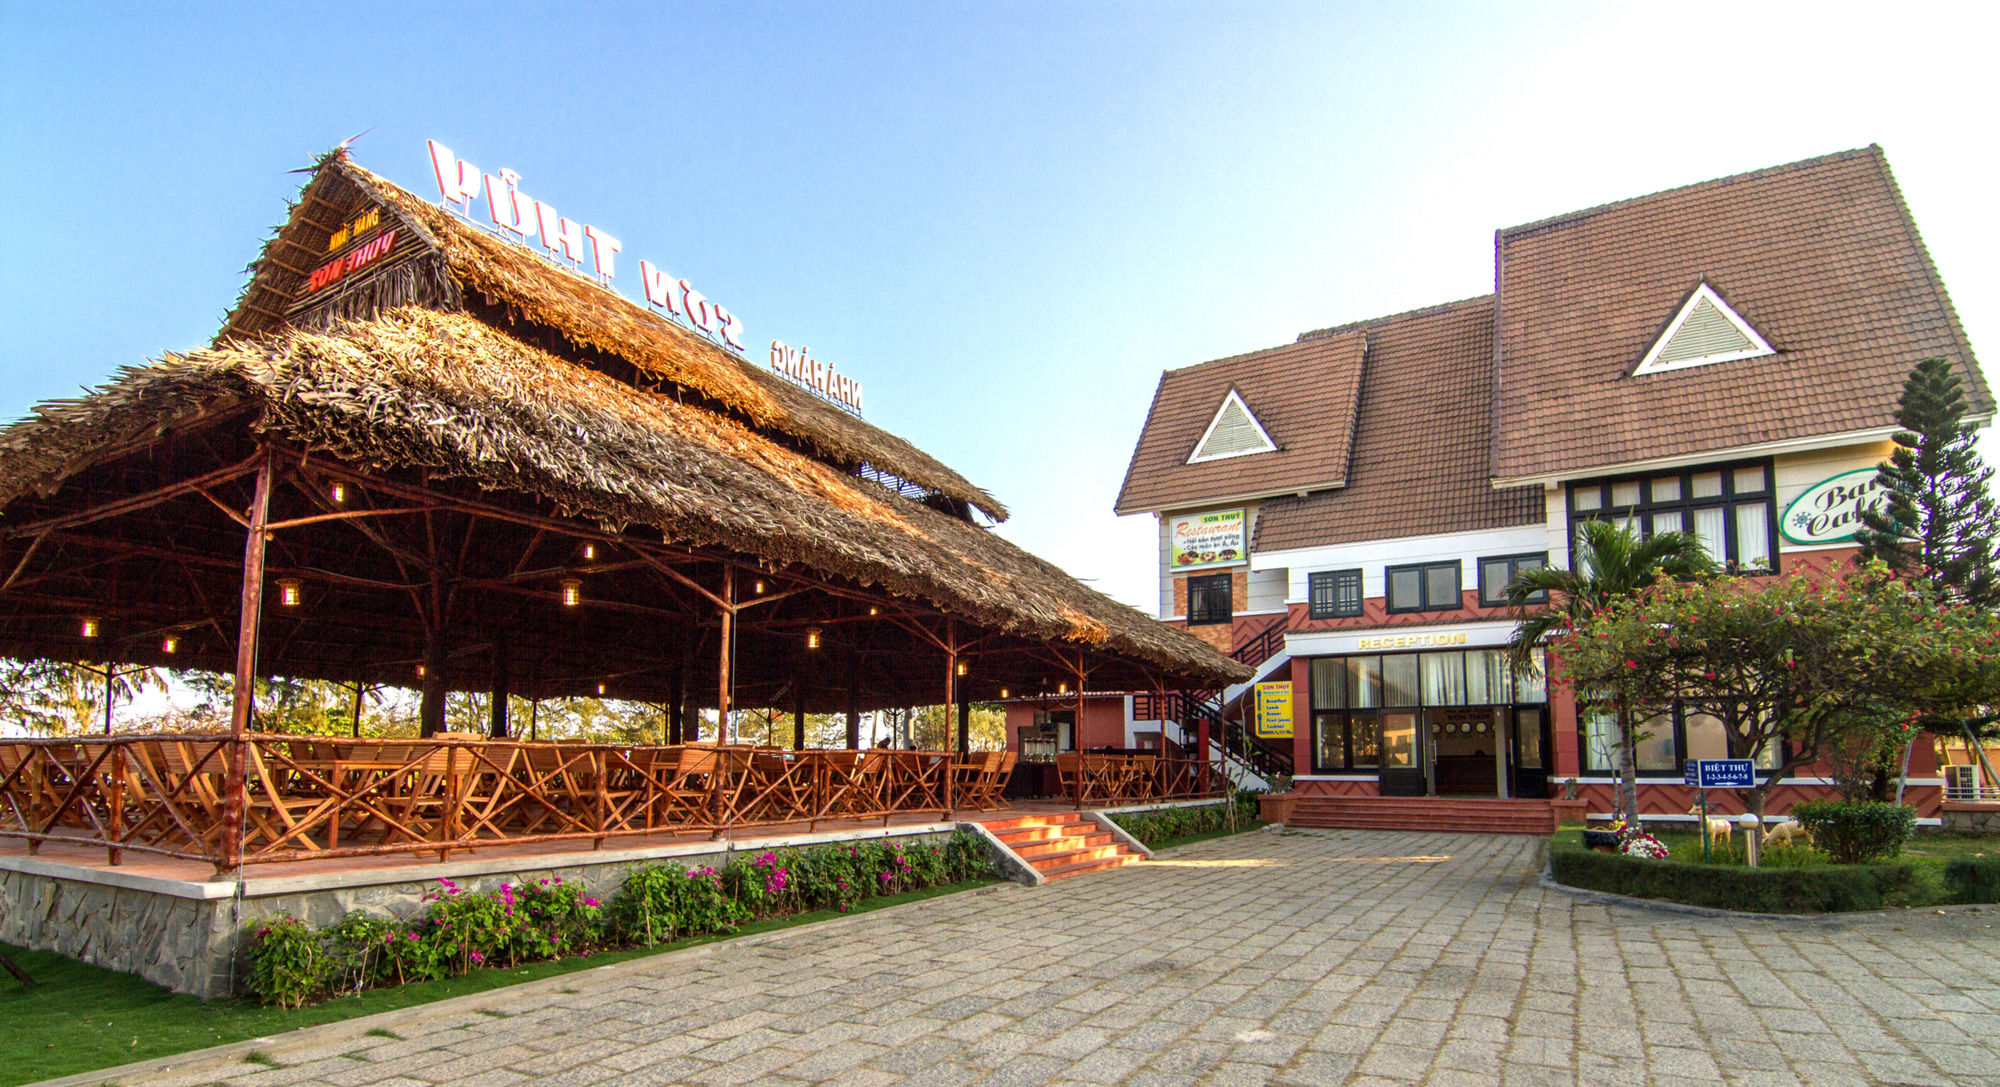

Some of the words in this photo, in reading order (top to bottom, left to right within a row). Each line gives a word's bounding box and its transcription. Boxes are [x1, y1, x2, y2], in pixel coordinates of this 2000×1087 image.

[1814, 478, 1878, 512] Bar
[1176, 521, 1242, 537] Restaurant
[1358, 632, 1467, 650] RECEPTION
[1705, 763, 1727, 773] BIỆT
[1706, 773, 1749, 781] 1-2-3-4-5-6-7-8
